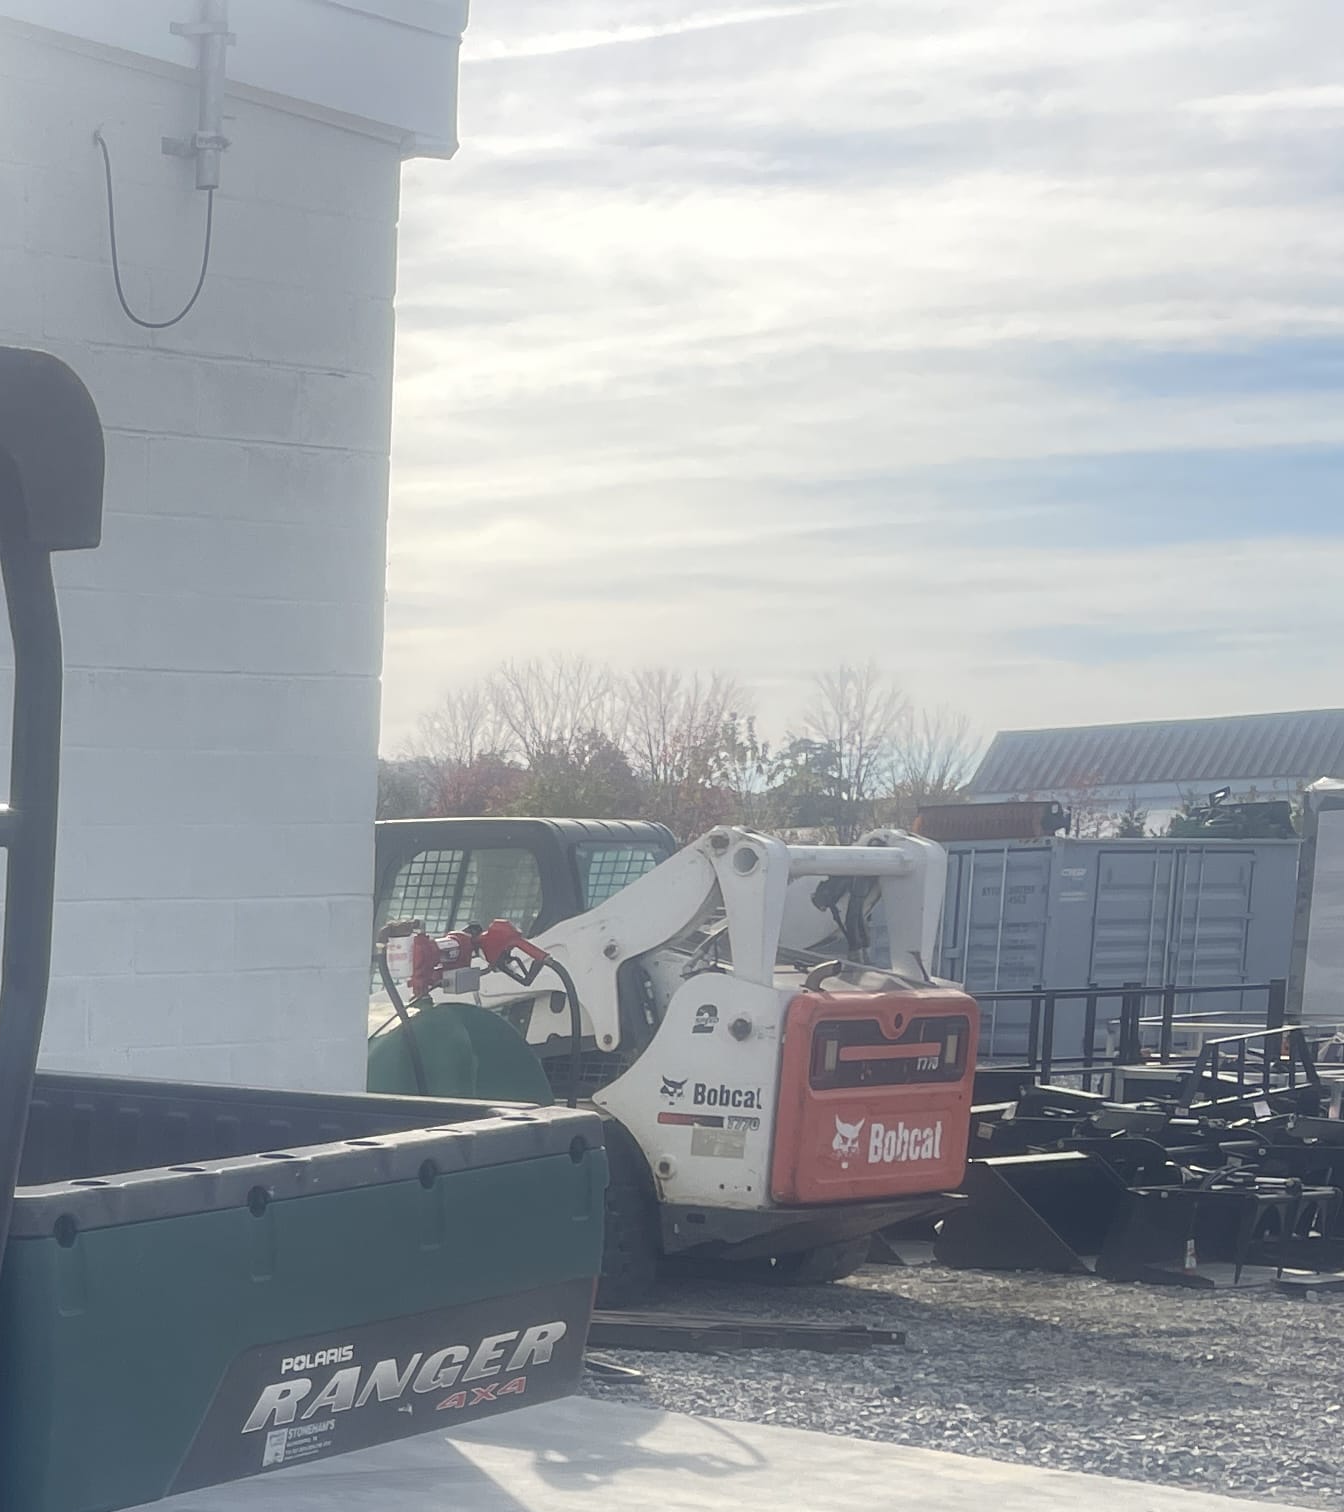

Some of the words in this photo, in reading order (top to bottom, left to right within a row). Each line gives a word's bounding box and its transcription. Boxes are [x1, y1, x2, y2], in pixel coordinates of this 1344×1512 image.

[693, 1083, 762, 1110] Bobcat
[868, 1121, 943, 1164] Bobcat
[241, 1320, 568, 1434] RANGER
[280, 1344, 355, 1375] POLARIS
